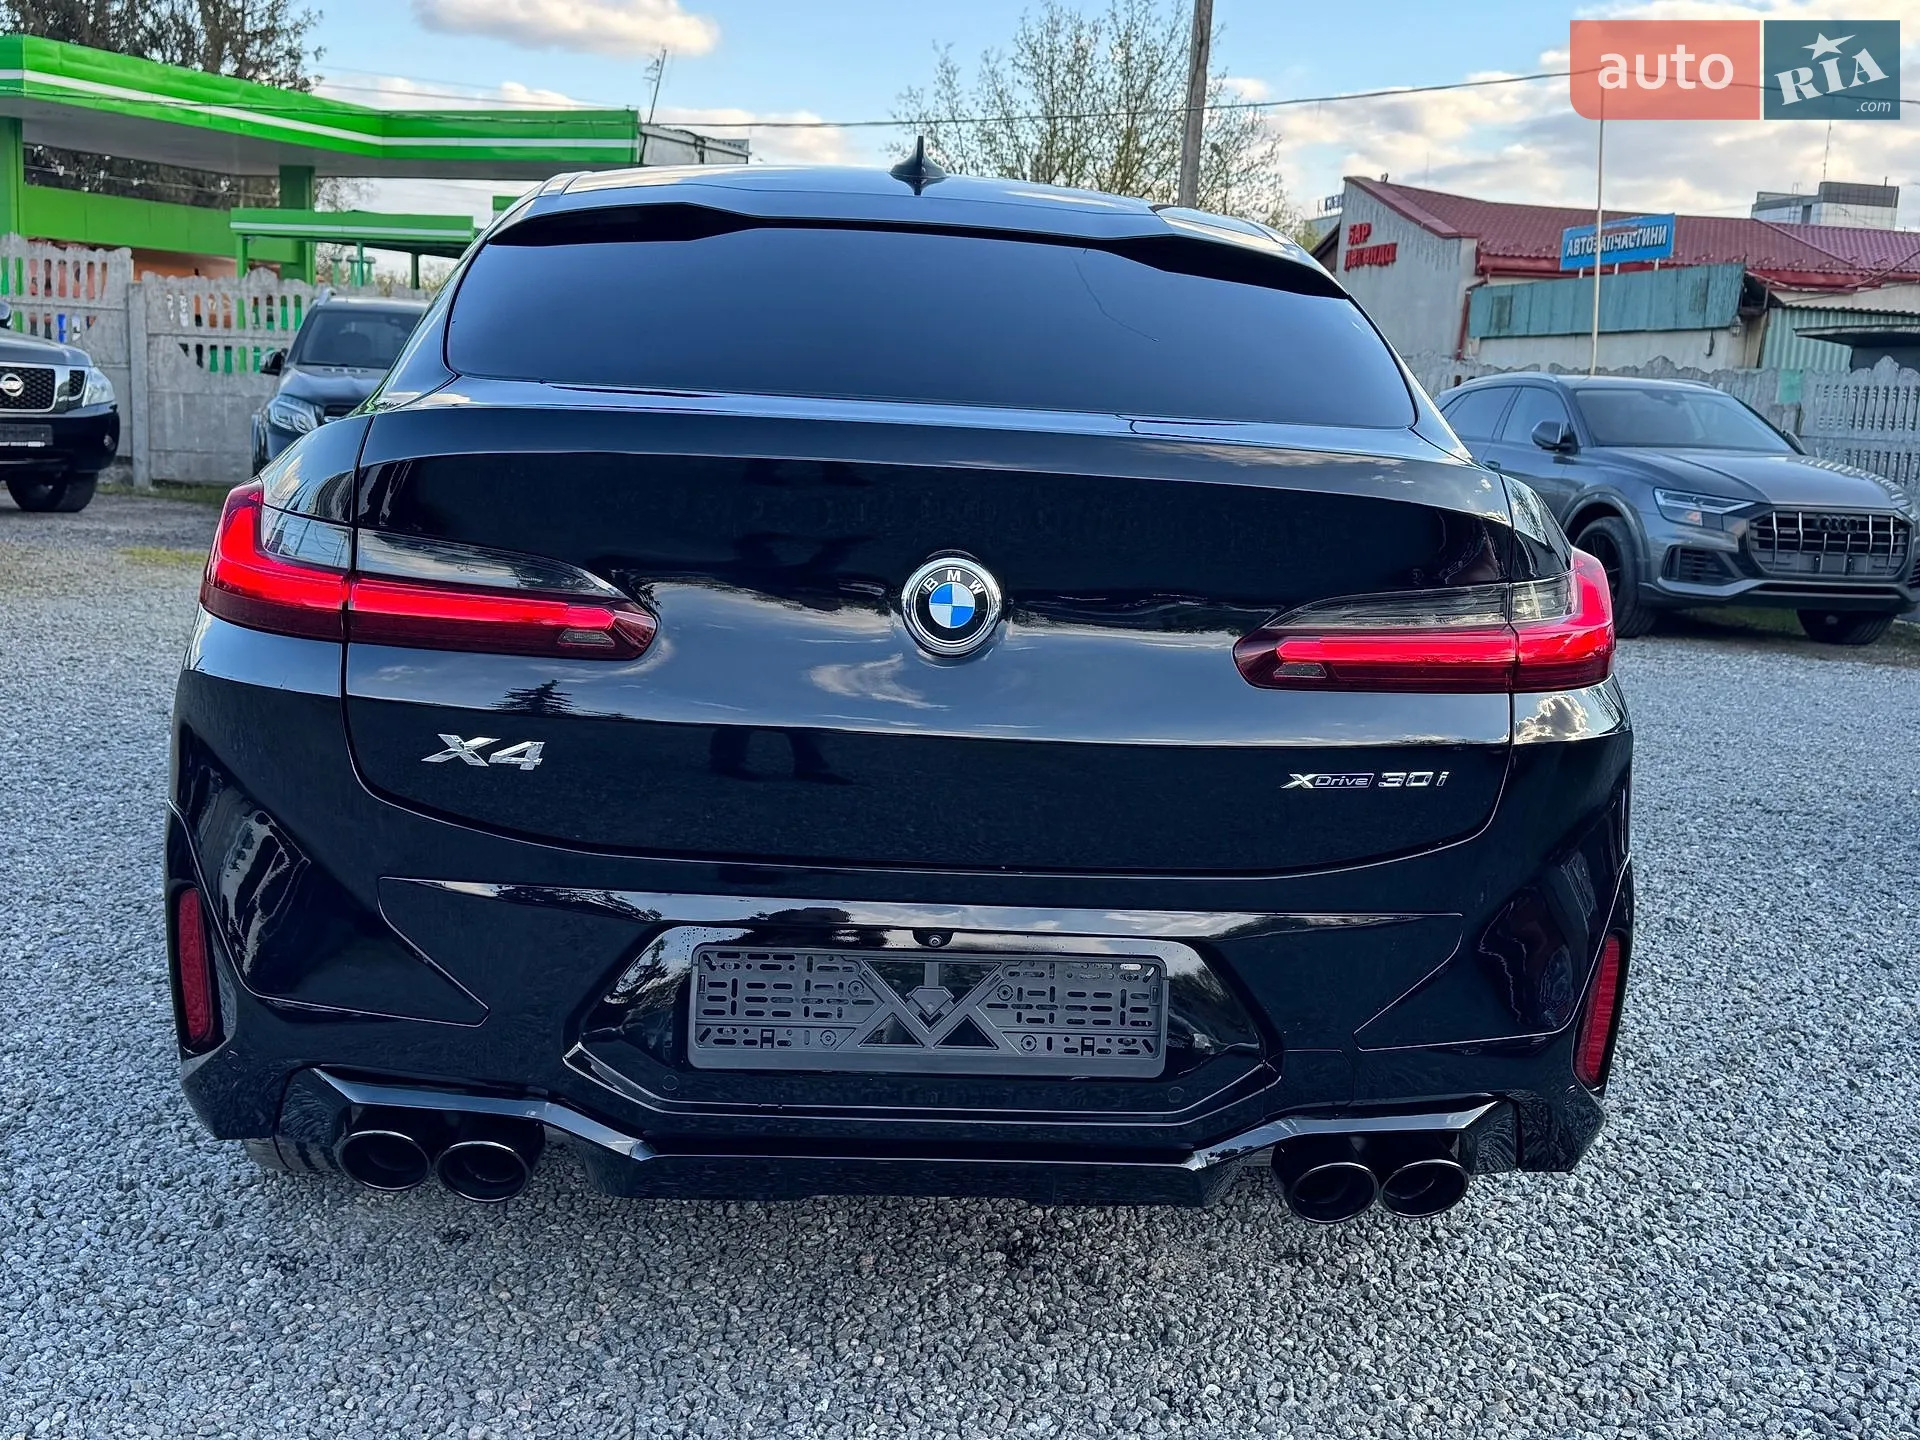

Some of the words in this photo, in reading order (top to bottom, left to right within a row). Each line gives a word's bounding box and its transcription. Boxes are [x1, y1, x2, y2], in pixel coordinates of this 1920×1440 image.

[1348, 223, 1371, 246] БАР
[923, 569, 984, 596] BMW
[421, 733, 546, 771] X4
